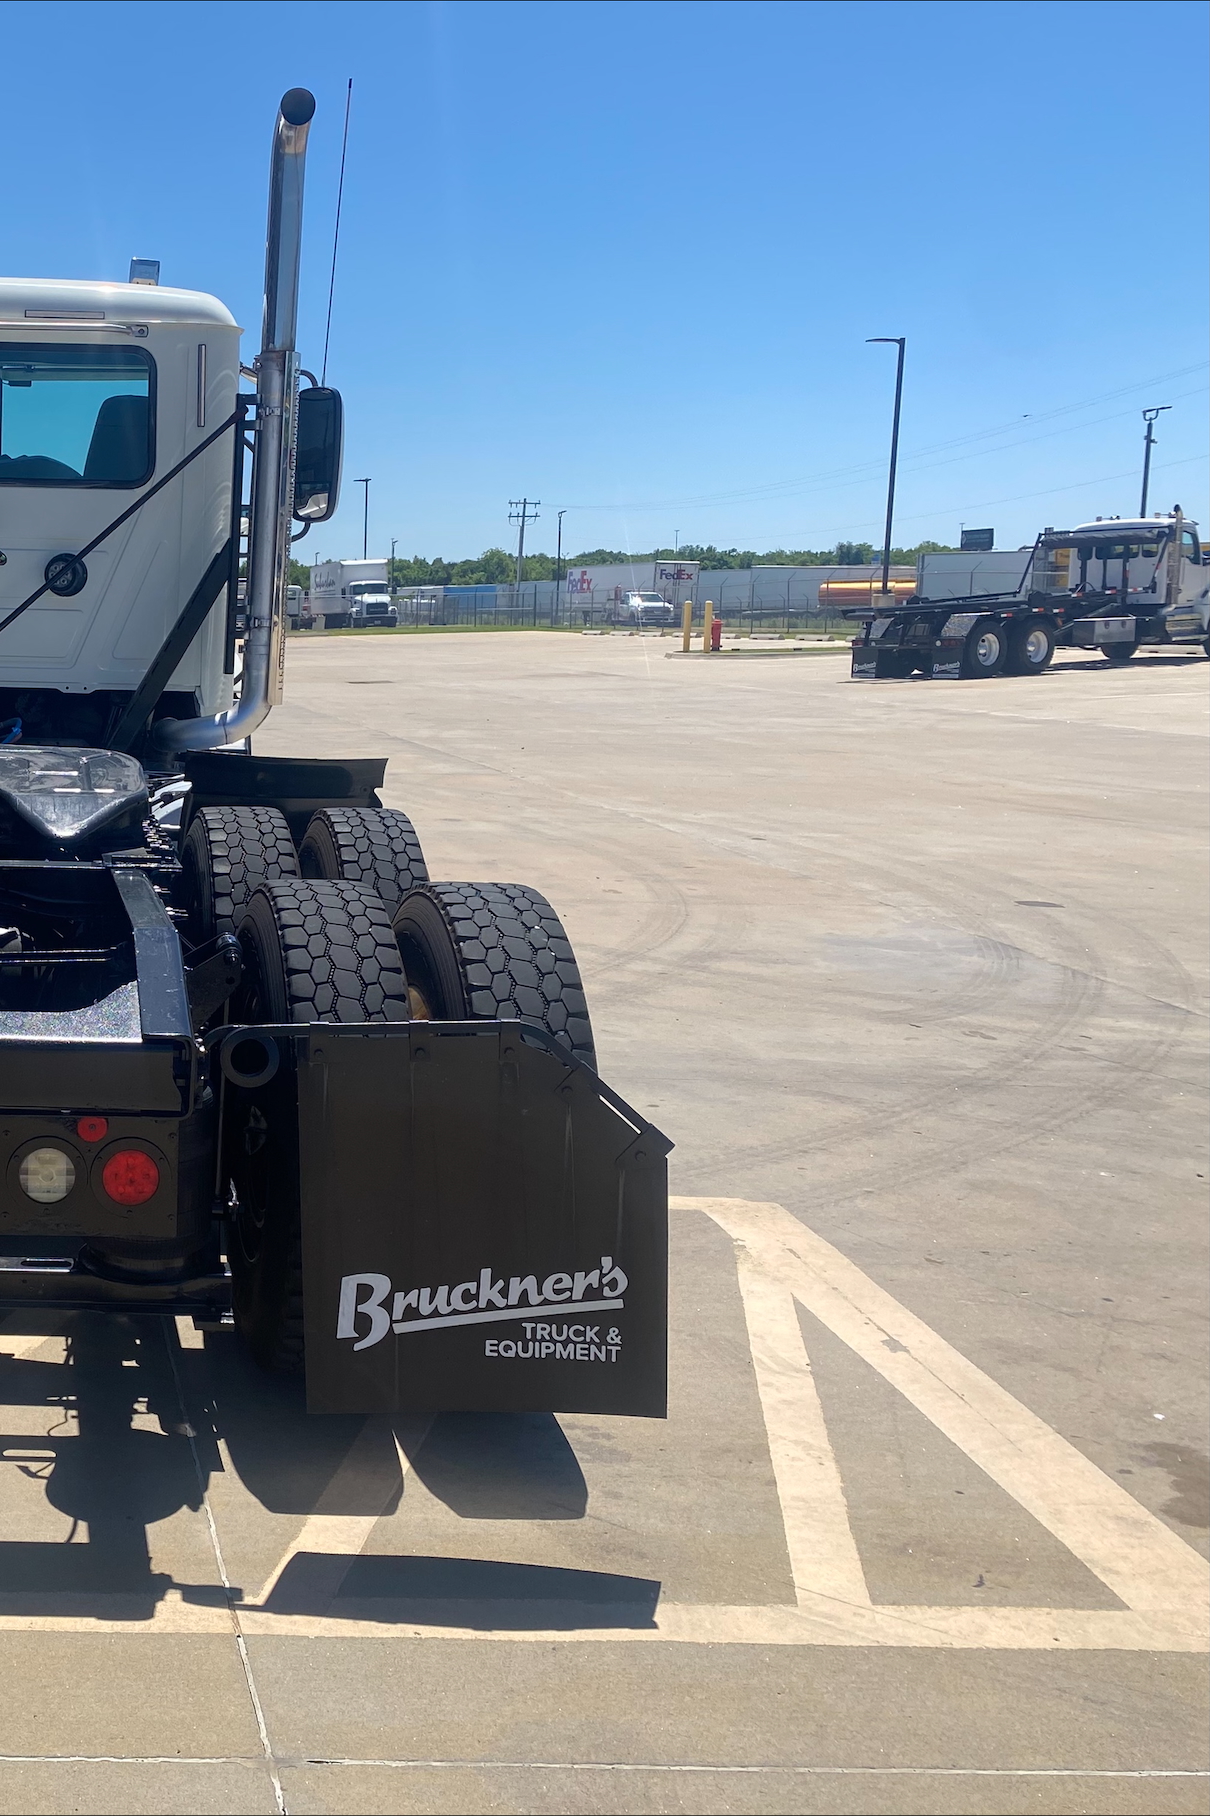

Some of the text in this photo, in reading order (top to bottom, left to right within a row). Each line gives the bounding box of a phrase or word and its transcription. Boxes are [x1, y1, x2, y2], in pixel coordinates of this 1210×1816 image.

[567, 570, 592, 594] FedEx
[659, 568, 693, 581] FedEx
[336, 1256, 629, 1352] Bruckner's
[521, 1322, 622, 1344] TRUCK &
[484, 1339, 622, 1363] EQUIPMENT
